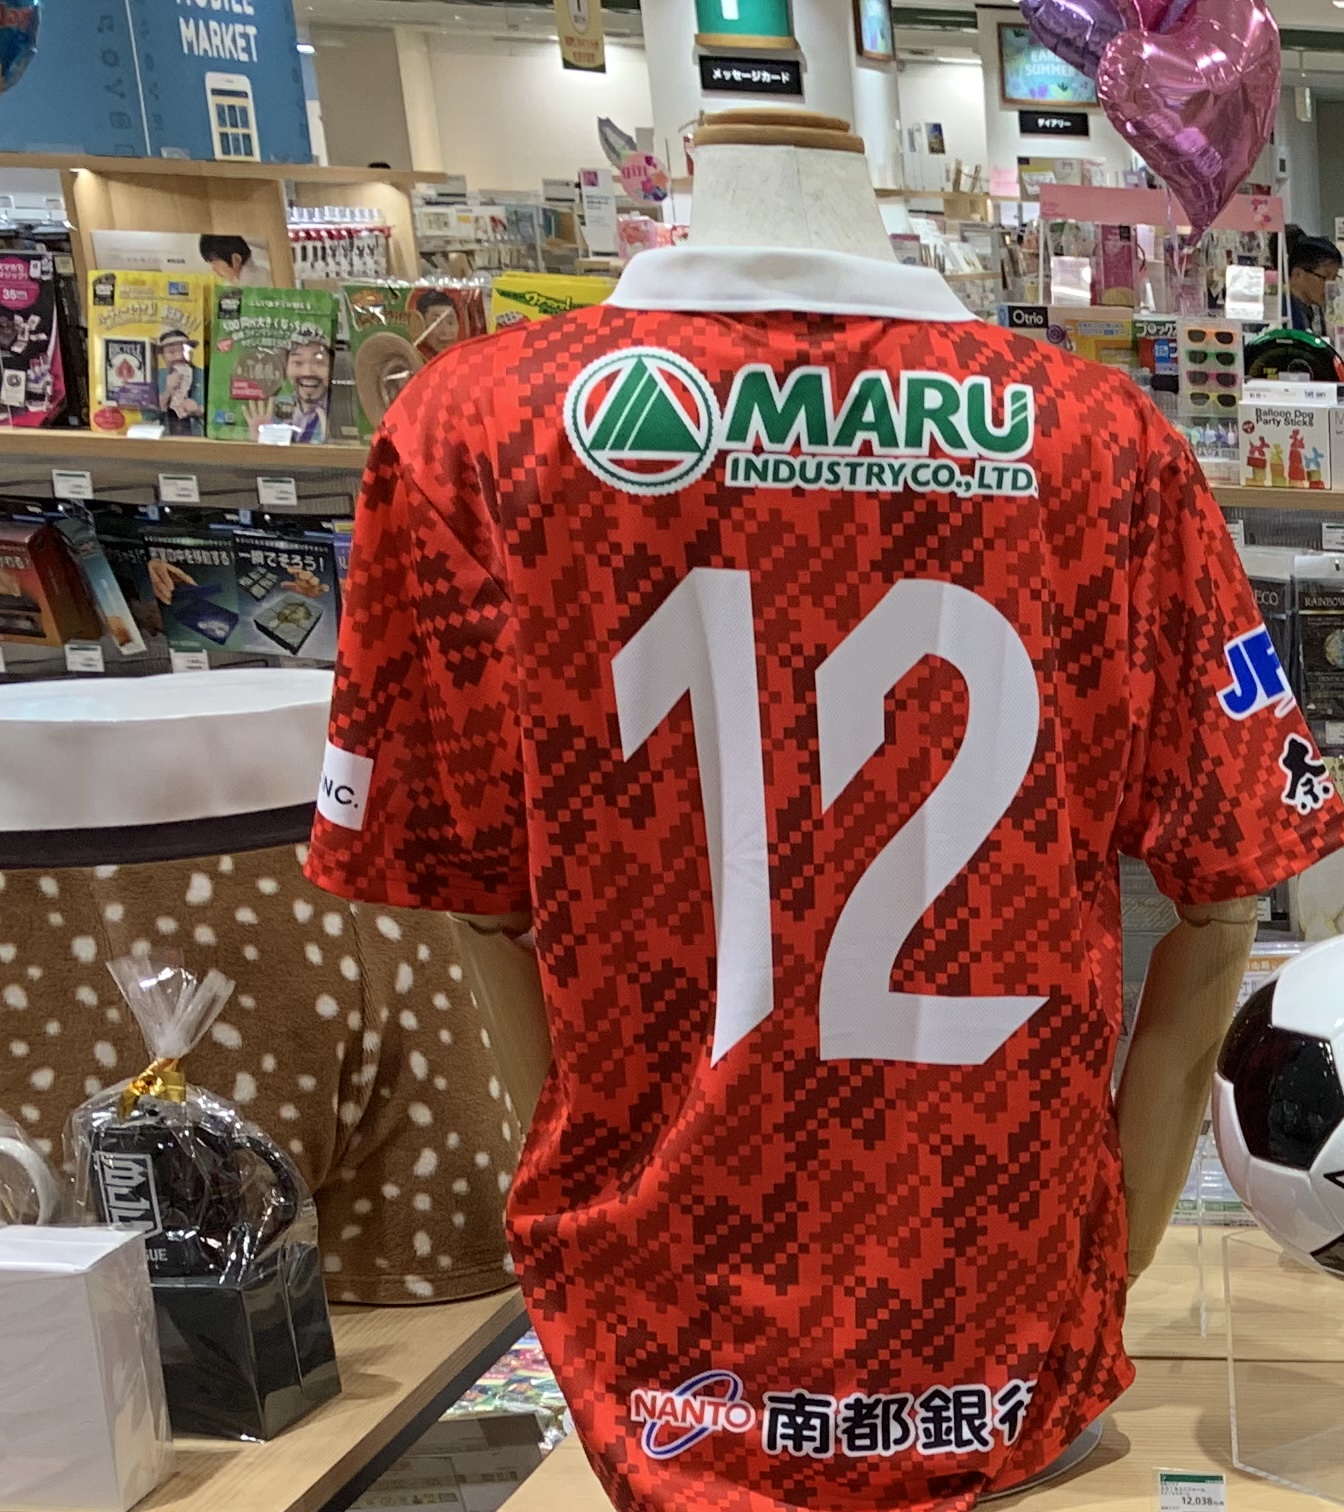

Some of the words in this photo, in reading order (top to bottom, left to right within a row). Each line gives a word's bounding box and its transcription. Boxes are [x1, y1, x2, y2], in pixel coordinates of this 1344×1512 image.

[178, 16, 258, 63] MARKET
[712, 68, 789, 84] メッセージカード
[1012, 309, 1044, 325] Otrio
[724, 369, 1034, 456] MARU
[1255, 408, 1292, 419] Balloon
[1256, 416, 1282, 428] Party
[1283, 417, 1314, 428] Sticks
[730, 456, 900, 487] INDUSTRY
[1217, 623, 1296, 720] JF
[611, 567, 1049, 1068] 12
[632, 1388, 755, 1432] NANTO
